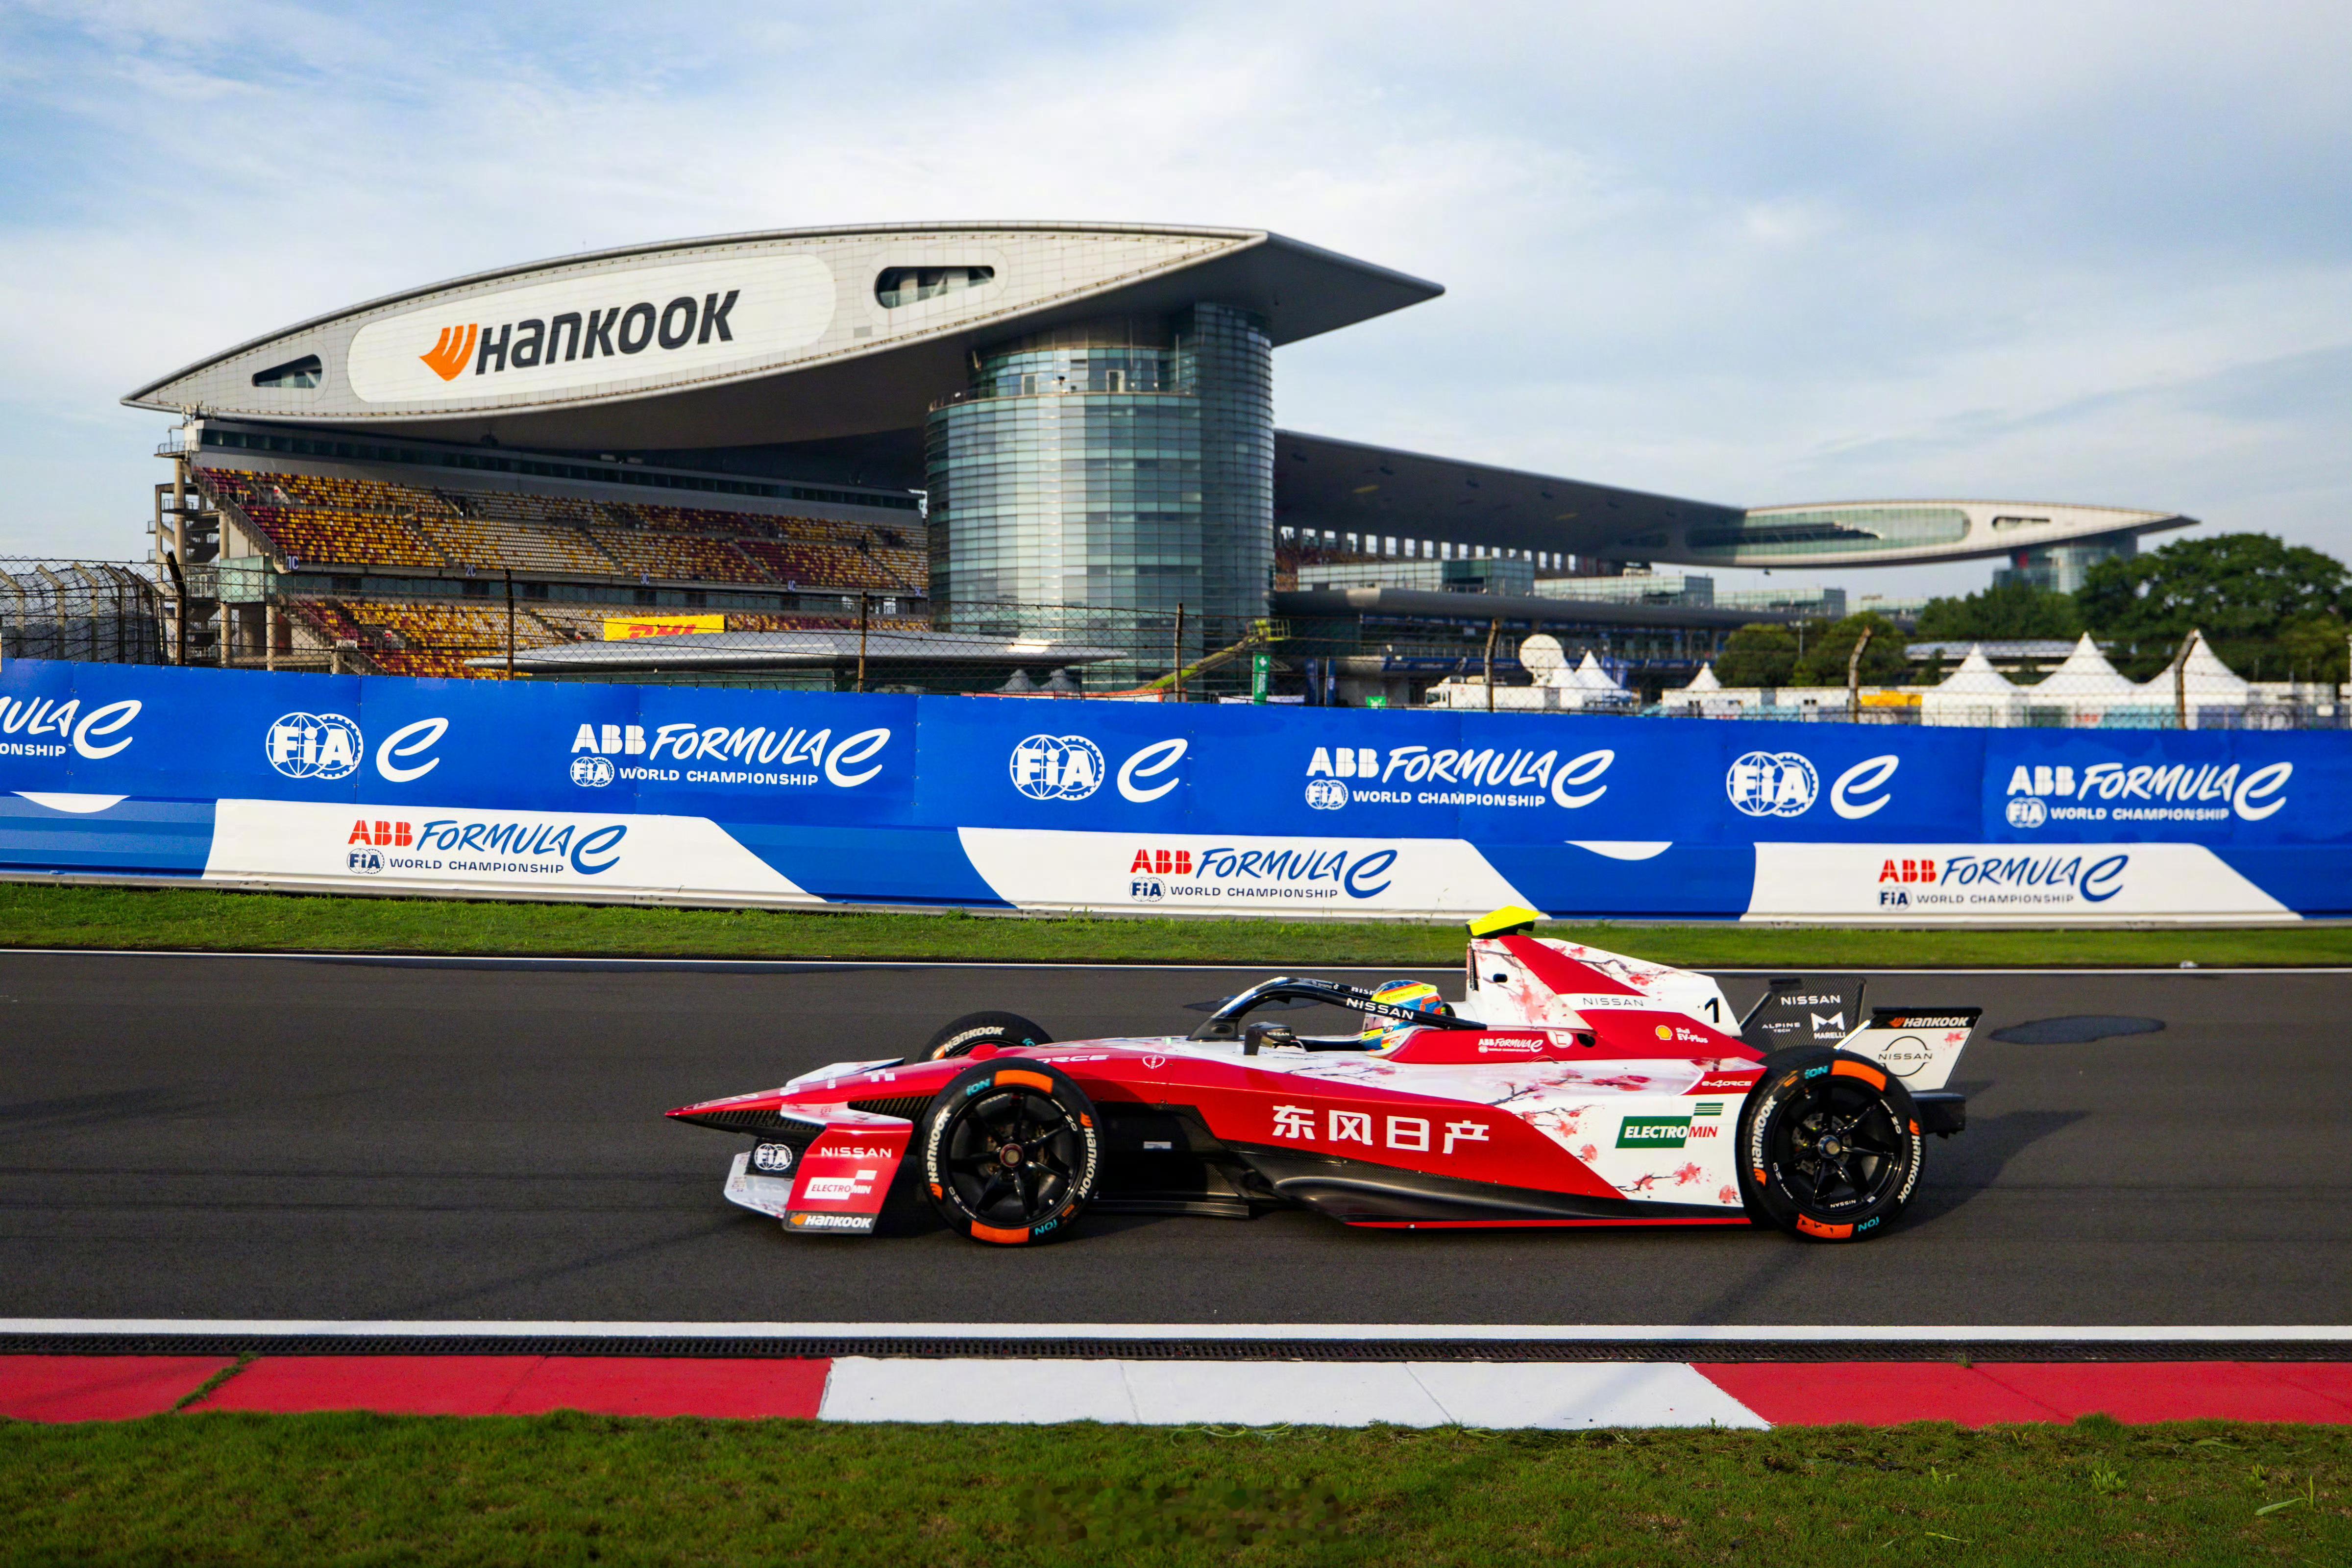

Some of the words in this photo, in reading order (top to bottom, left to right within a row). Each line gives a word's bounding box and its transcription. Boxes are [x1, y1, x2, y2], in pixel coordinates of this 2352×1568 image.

[287, 555, 299, 569] 1C
[466, 565, 476, 577] 2C
[640, 572, 650, 585] 3C
[788, 580, 796, 591] 4C
[571, 724, 646, 754] ABB
[650, 723, 832, 766] FORMULA
[1306, 747, 1379, 778] ABB
[1382, 746, 1558, 787] FORMULA
[619, 767, 680, 781] WORLD
[686, 770, 818, 786] CHAMPIONSHIP
[2007, 765, 2075, 796] ABB
[2078, 763, 2241, 802] FORMULA
[1353, 790, 1411, 803] WORLD
[1418, 792, 1545, 807] CHAMPIONSHIP
[2050, 807, 2106, 820] WORLD
[2113, 808, 2229, 821] CHAMPIONSHIP
[348, 820, 412, 846] ABB
[417, 820, 575, 857] FORMULA
[390, 858, 442, 870] WORLD
[449, 860, 564, 874] CHAMPIONSHIP
[1129, 849, 1192, 874] ABB
[1197, 848, 1348, 882] FORMULA
[1879, 860, 1936, 882] ABB
[1941, 856, 2082, 886] FORMULA
[1171, 886, 1221, 896] WORLD
[1227, 888, 1338, 898] CHAMPIONSHIP
[1916, 895, 1964, 904] WORLD
[1970, 895, 2074, 904] CHAMPIONSHIP
[1583, 998, 1644, 1006] NISSAN
[1781, 995, 1841, 1005] NISSAN
[1347, 998, 1414, 1020] NISSAN
[1705, 997, 1719, 1023] 1
[1494, 1038, 1531, 1048] FORMULA
[1677, 1033, 1708, 1043] EV-Plus
[1272, 1105, 1489, 1154] 东风日产
[1624, 1126, 1718, 1139] ELECTROMIN
[821, 1147, 892, 1158] NISSAN
[811, 1184, 871, 1194] ELECTROMIN
[1830, 1199, 1856, 1208] NISSAN
